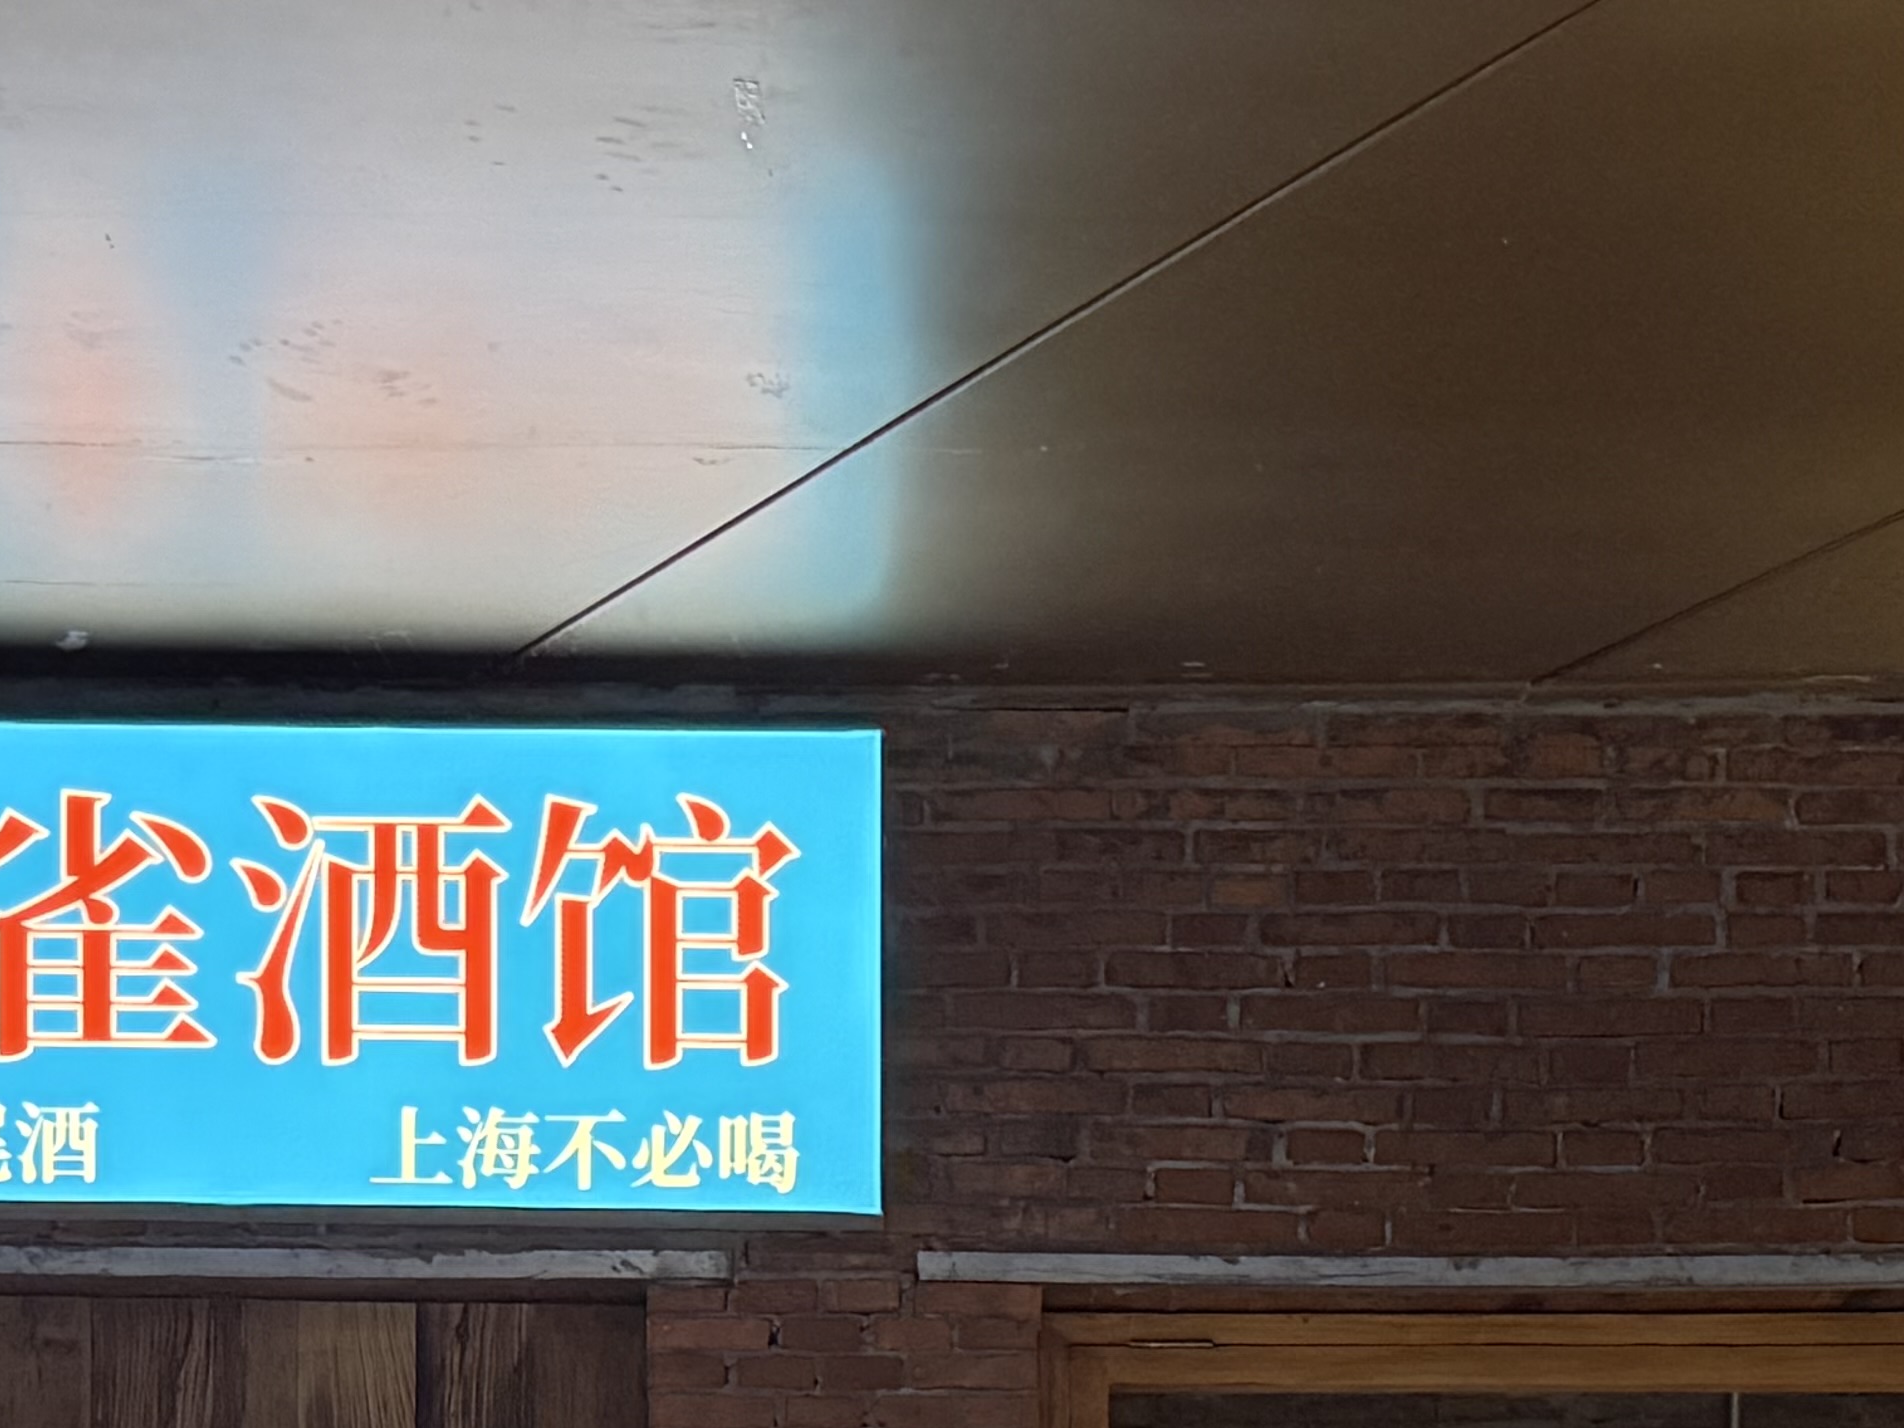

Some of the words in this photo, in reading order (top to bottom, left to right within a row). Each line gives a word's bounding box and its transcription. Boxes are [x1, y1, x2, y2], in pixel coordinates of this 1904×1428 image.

[369, 1107, 800, 1195] 上海不必喝
